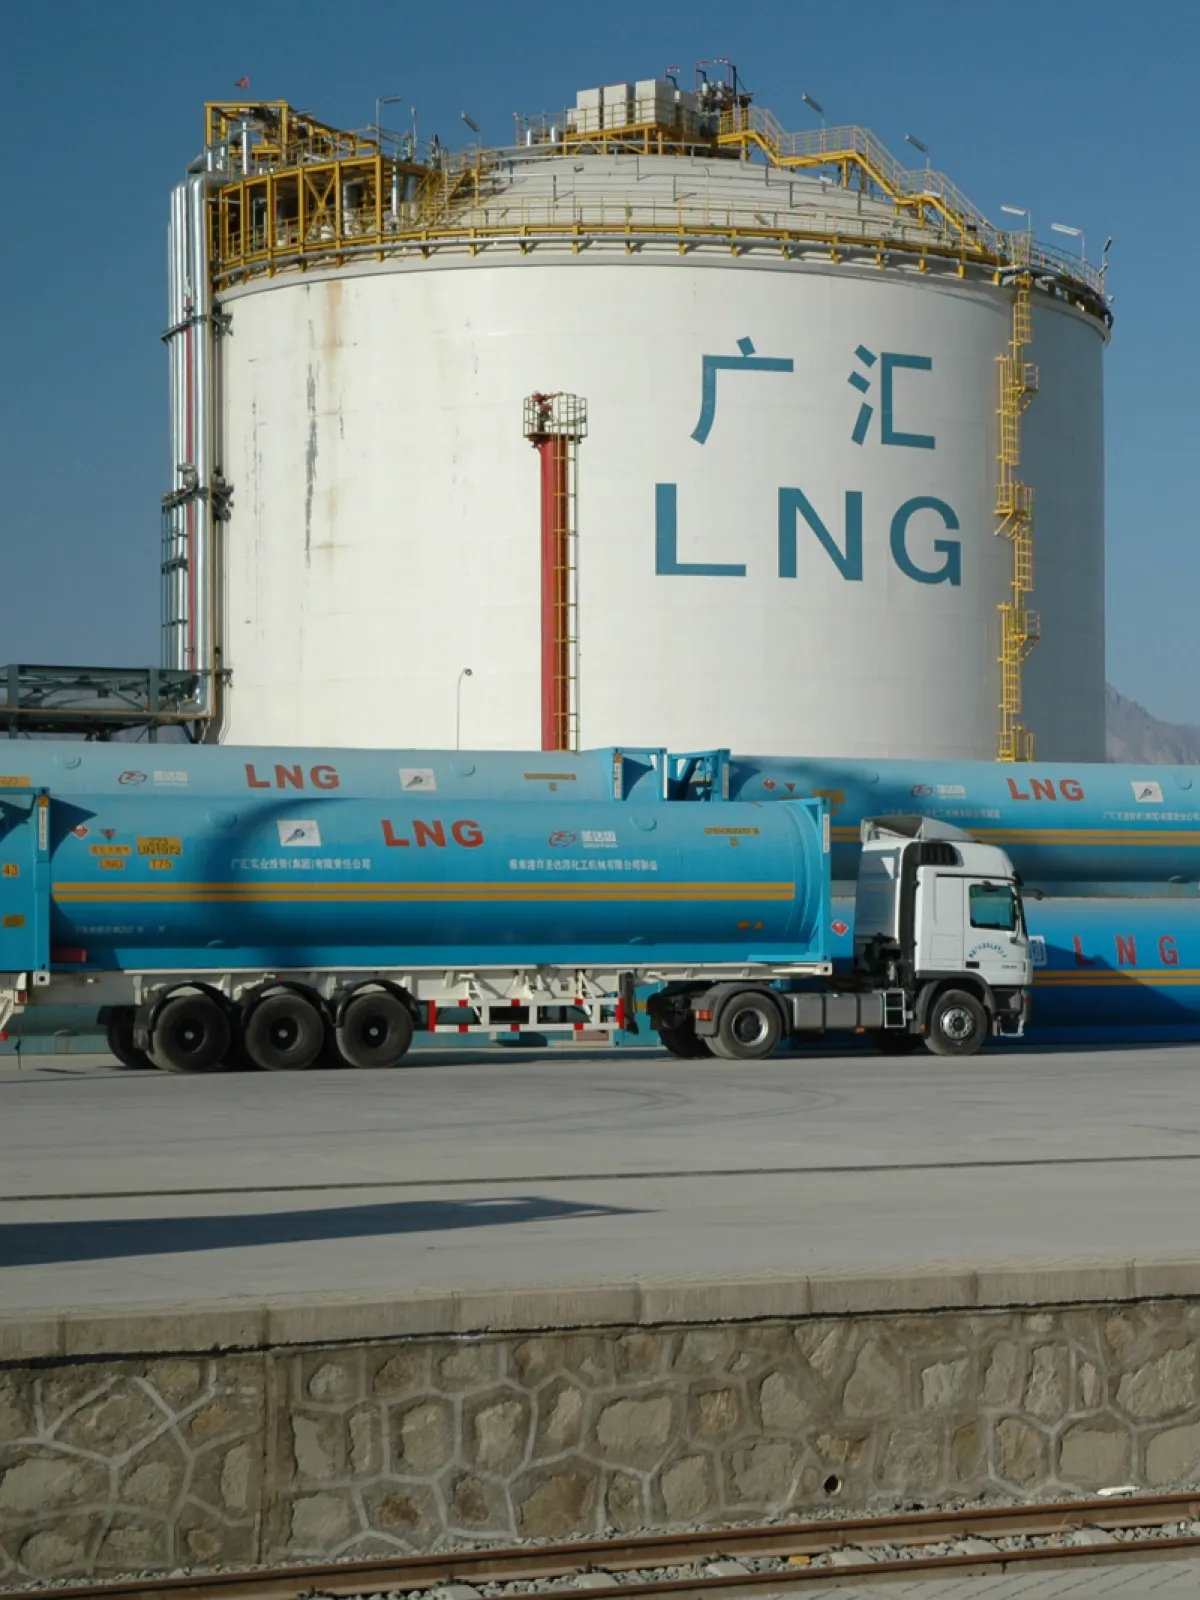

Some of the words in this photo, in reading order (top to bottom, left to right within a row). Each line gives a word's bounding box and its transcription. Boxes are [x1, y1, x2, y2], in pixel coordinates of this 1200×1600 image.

[691, 337, 935, 449] 广汇
[656, 484, 961, 586] LNG
[245, 764, 340, 789] LNG
[1006, 778, 1085, 801] LNG
[381, 819, 484, 848] LNG
[1073, 935, 1178, 965] LNG
